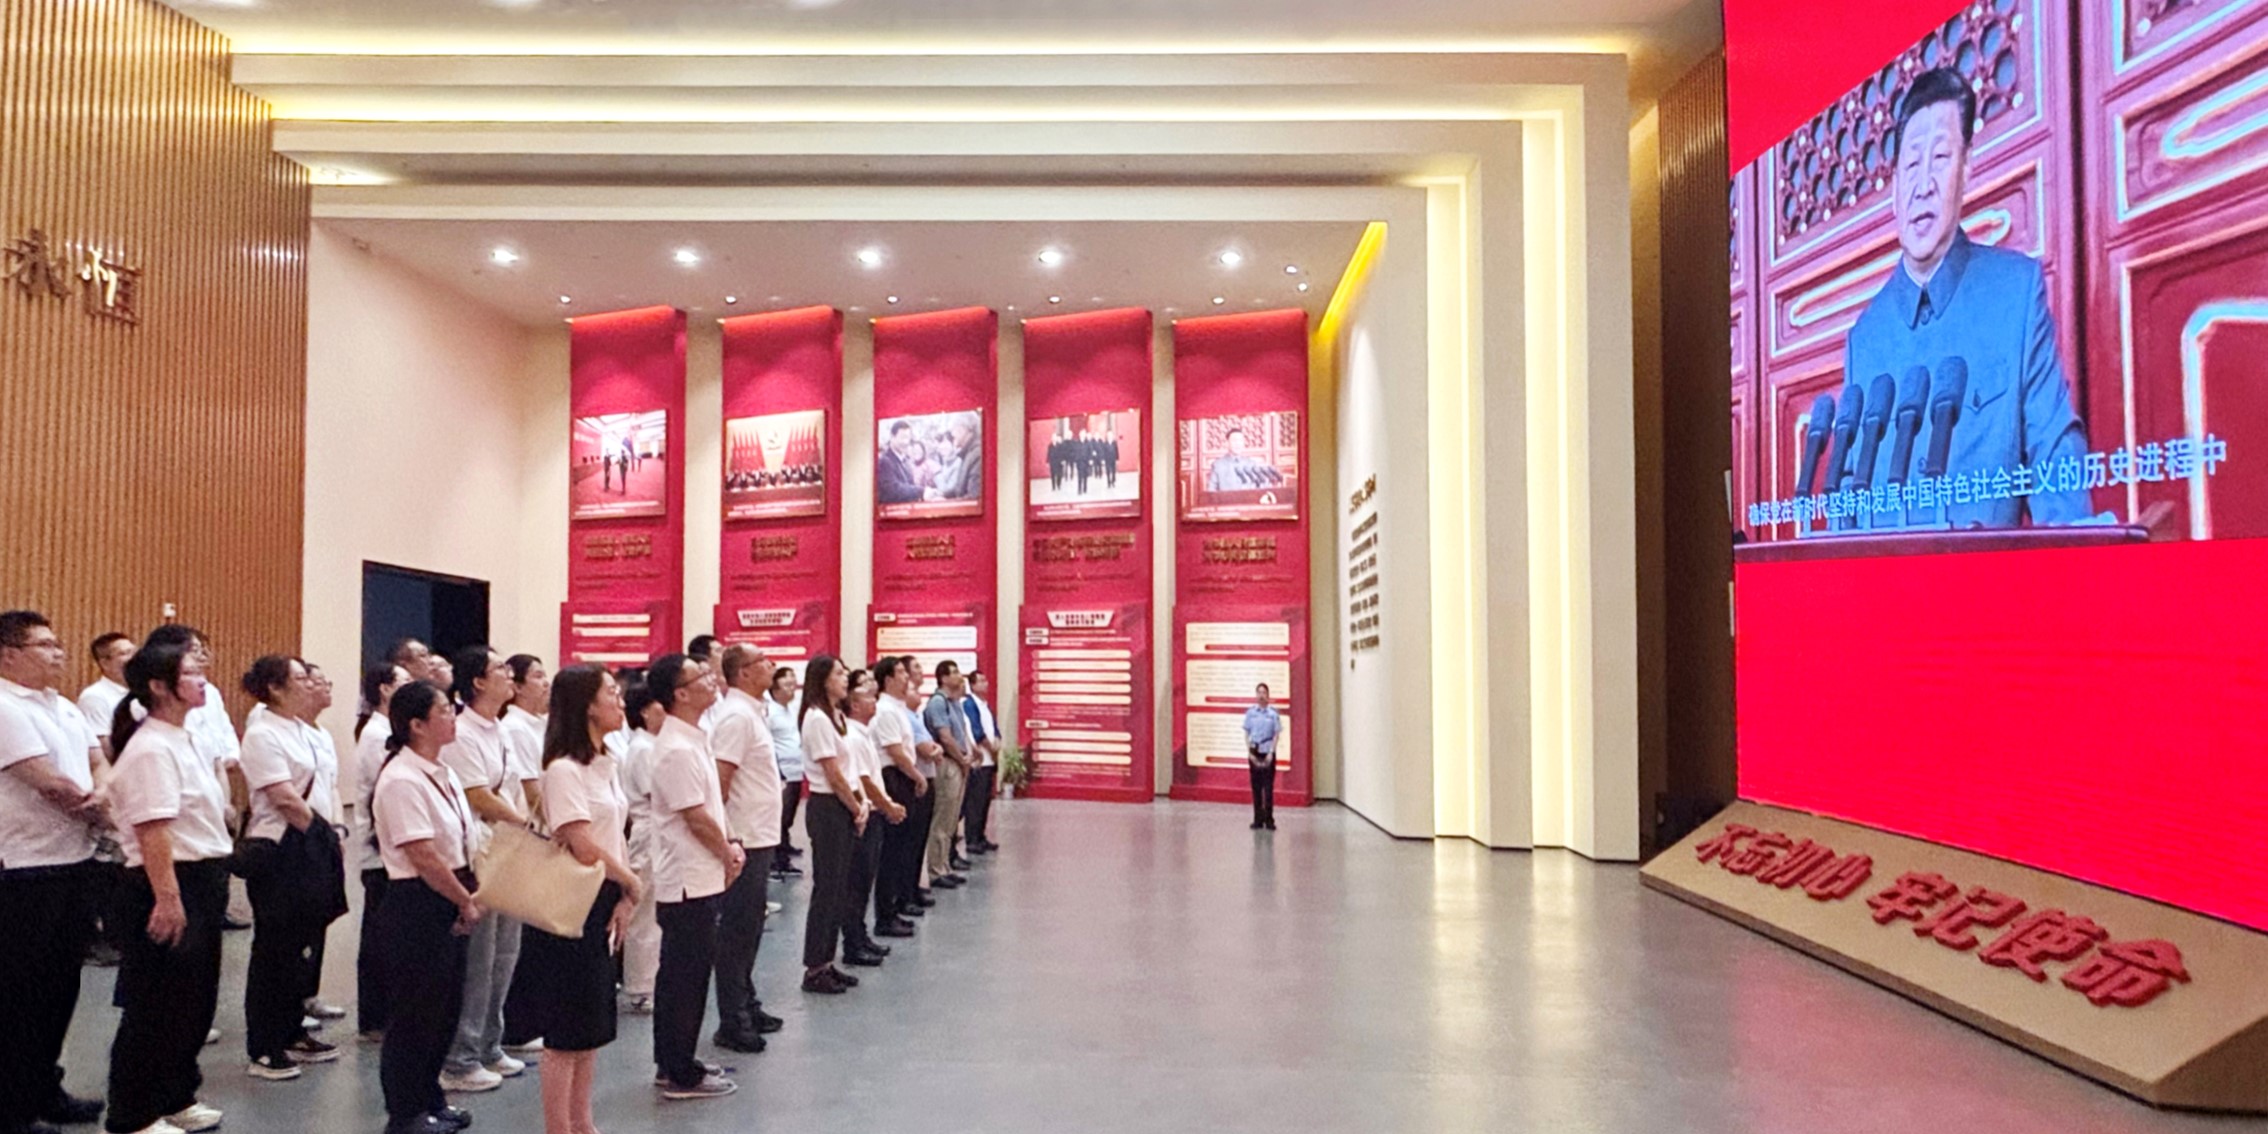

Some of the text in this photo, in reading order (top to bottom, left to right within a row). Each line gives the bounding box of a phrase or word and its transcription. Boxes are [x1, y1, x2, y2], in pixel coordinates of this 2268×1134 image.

[1748, 433, 2227, 527] 确保党在新时代坚持和发展中国特色社会主义的历史进程中
[1695, 822, 2192, 1008] 不忘初心 牢记使命
